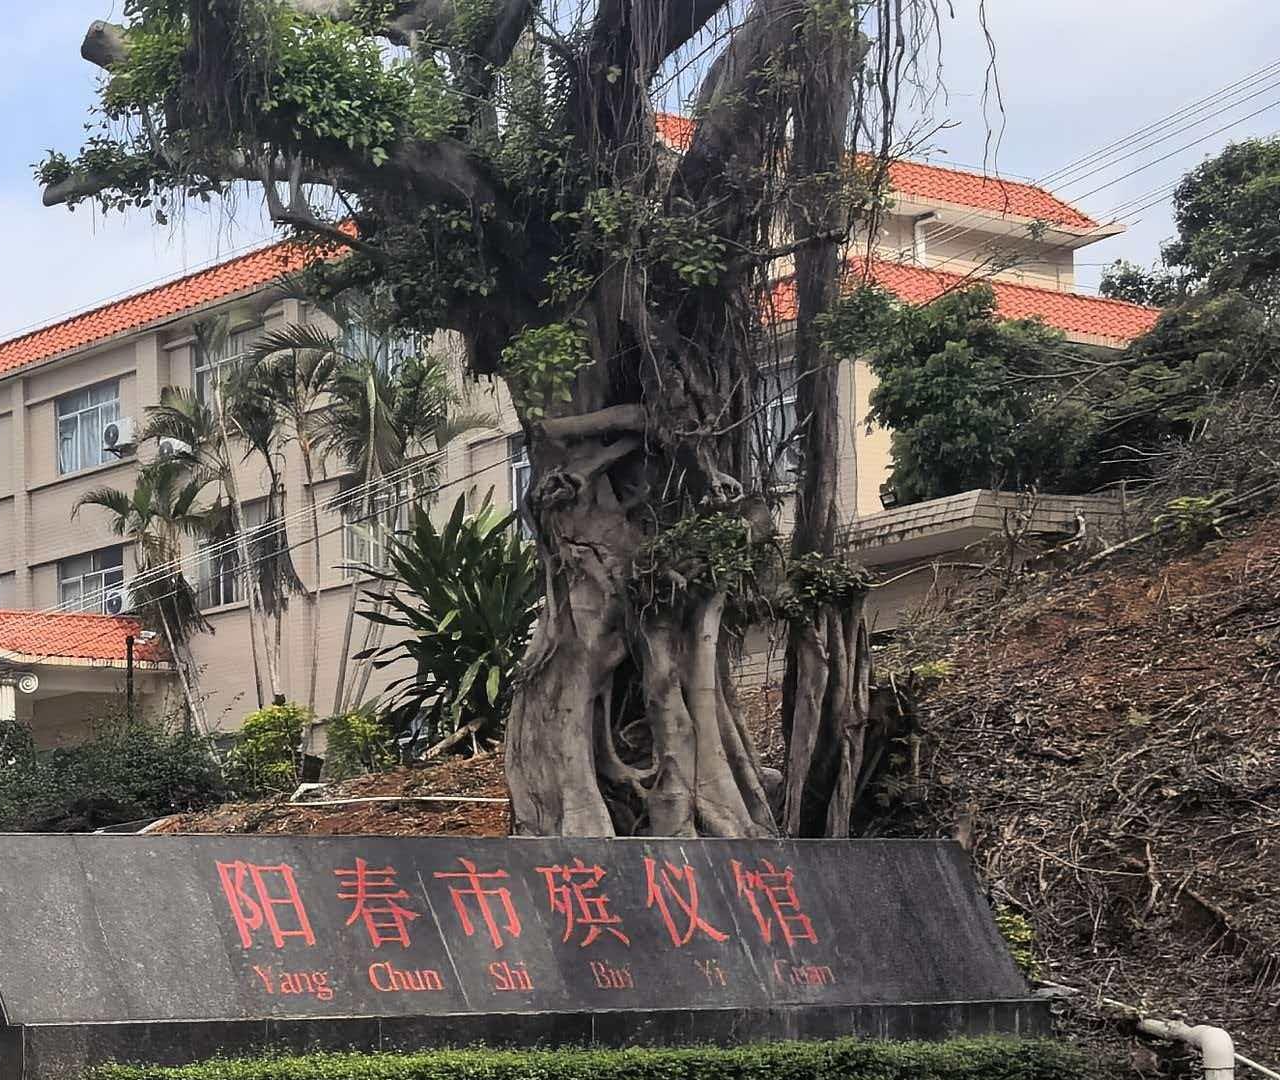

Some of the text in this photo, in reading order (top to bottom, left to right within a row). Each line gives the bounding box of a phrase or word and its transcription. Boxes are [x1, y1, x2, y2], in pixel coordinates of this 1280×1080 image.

[215, 856, 818, 949] 阳春市殡仪馆
[253, 964, 334, 1000] Yang
[368, 960, 445, 993] Chun
[489, 959, 534, 992] Shi
